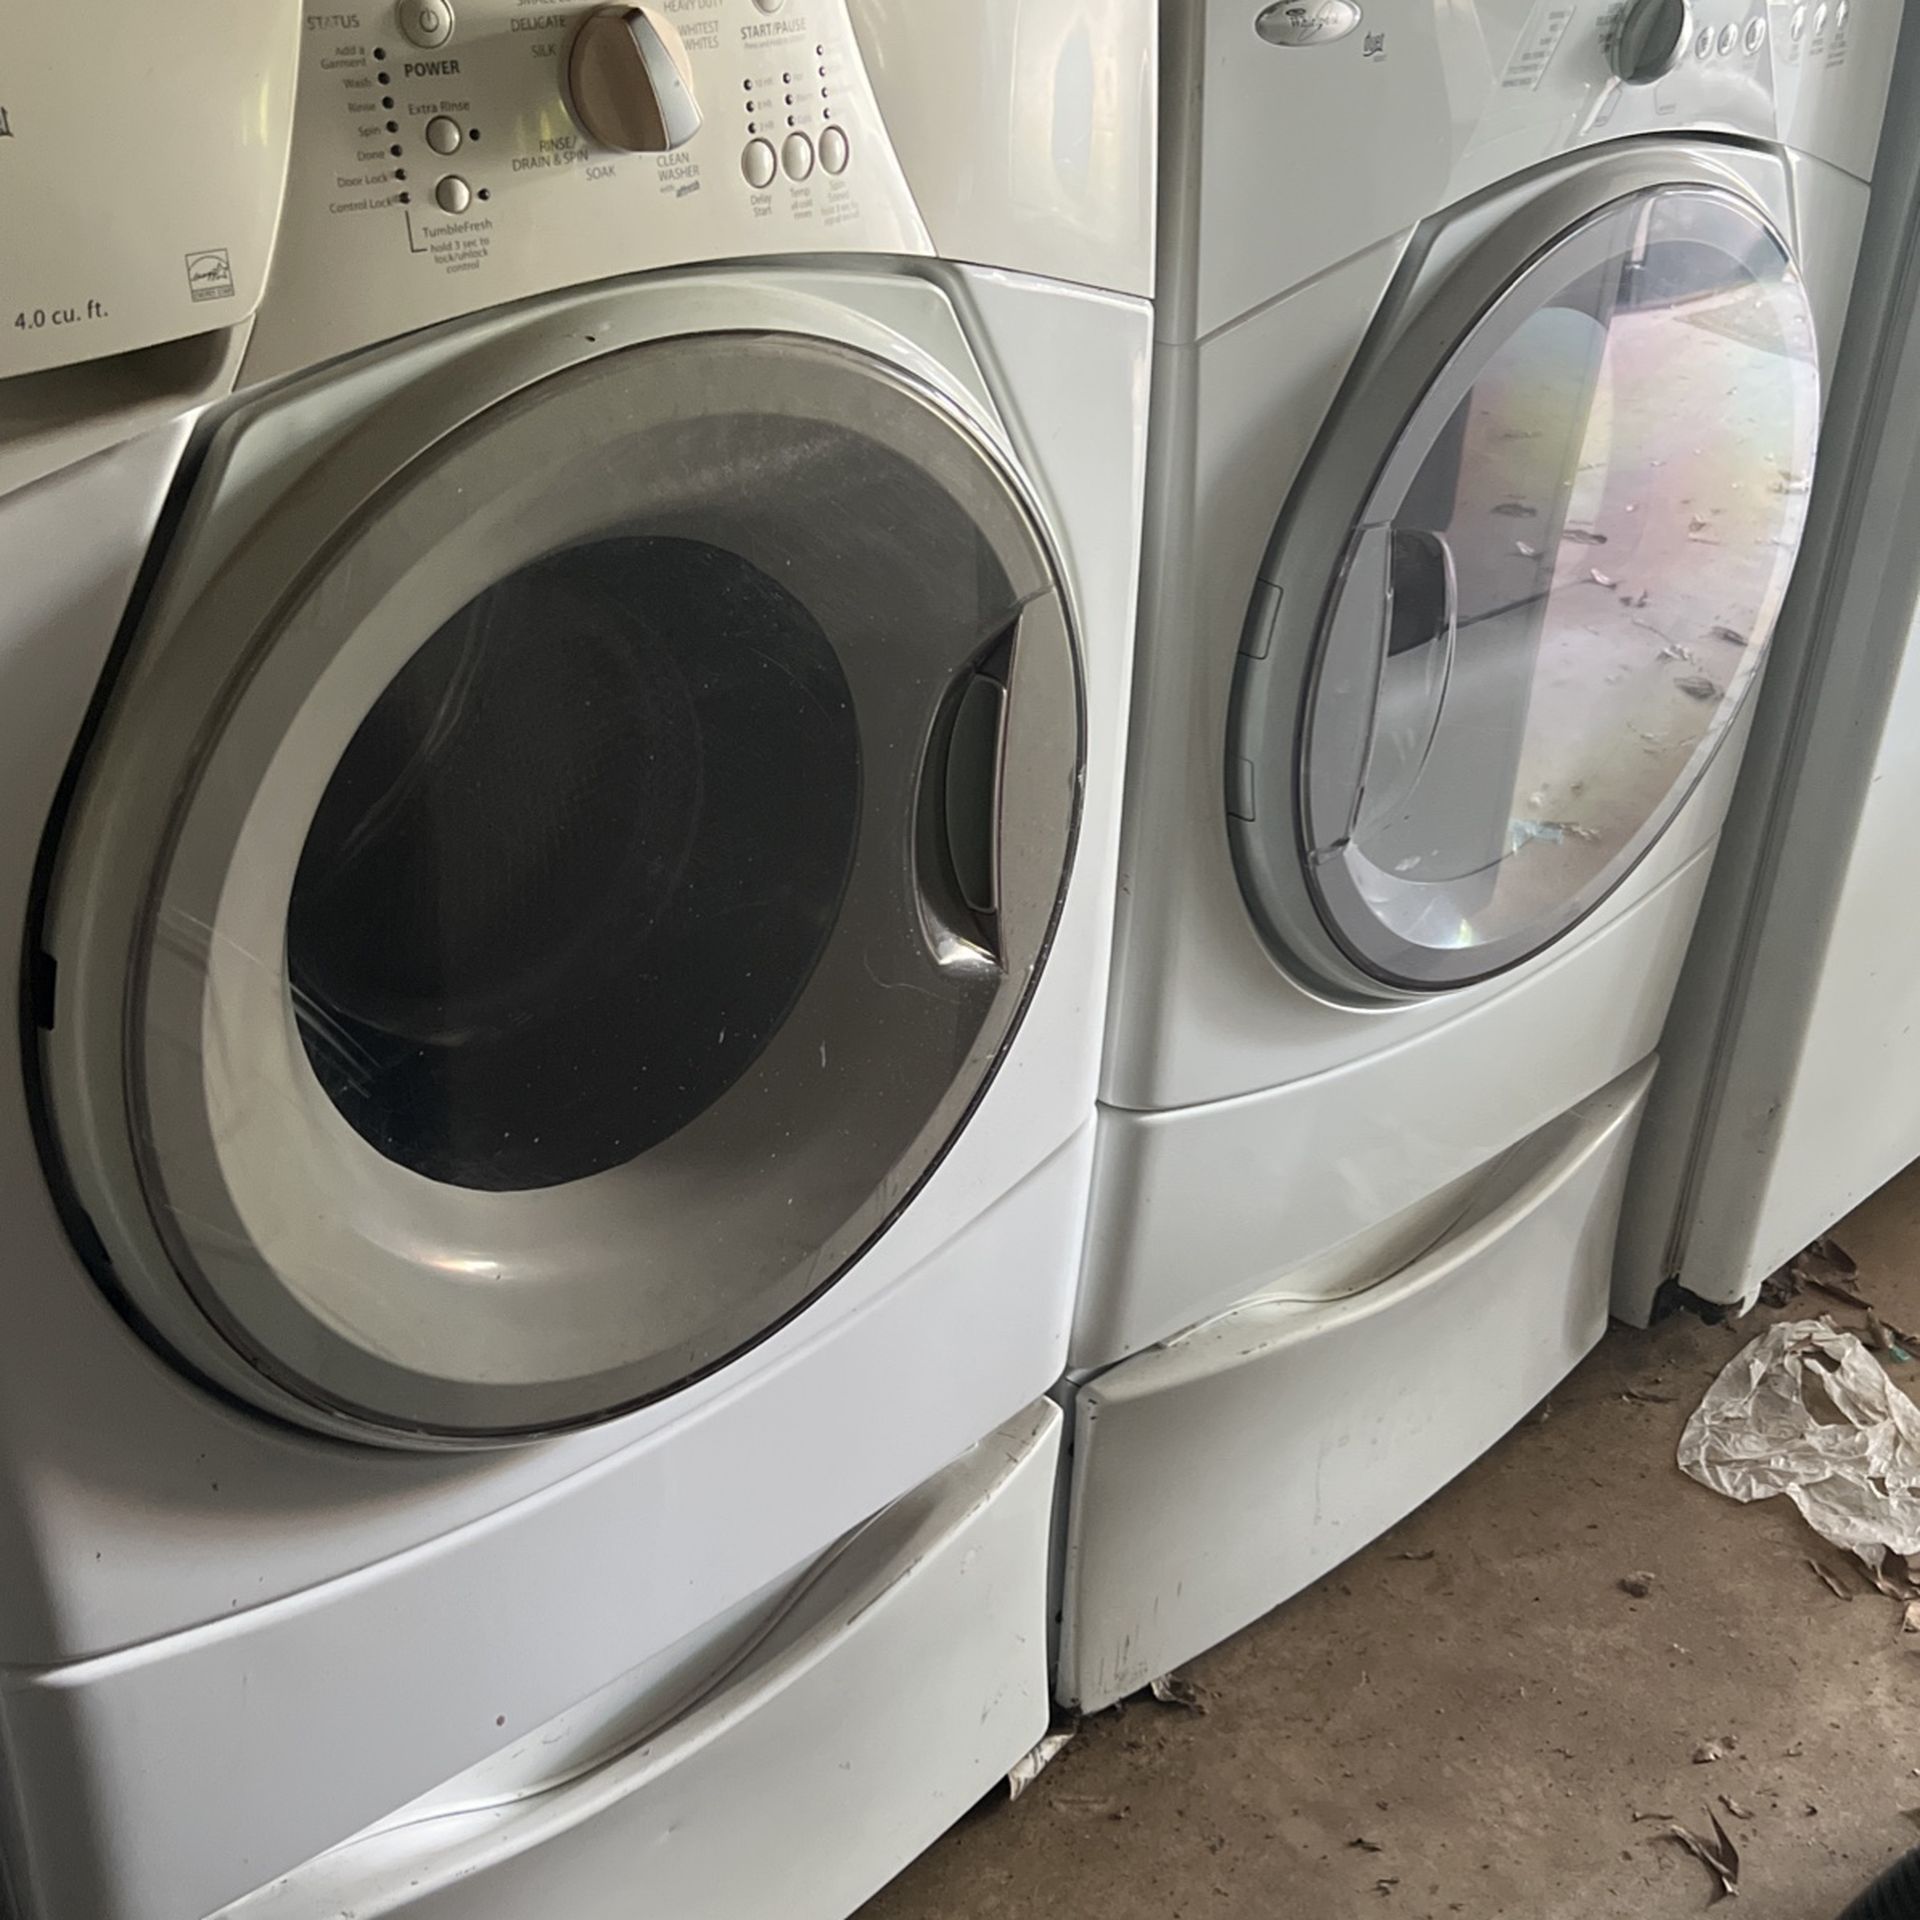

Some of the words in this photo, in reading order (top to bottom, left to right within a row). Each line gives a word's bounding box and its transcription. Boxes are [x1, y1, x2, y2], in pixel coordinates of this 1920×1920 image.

[664, 0, 695, 12] HEAVY
[698, 0, 723, 9] DUTY
[511, 15, 567, 32] DELICATE
[678, 20, 719, 36] WHITEST
[740, 18, 806, 40] START/PAUSE
[683, 35, 719, 50] WHITES
[532, 44, 557, 58] SILK
[404, 60, 460, 77] POWER
[409, 104, 438, 116] Extra
[440, 100, 470, 112] Rinse
[539, 136, 576, 152] RINSE/
[357, 150, 385, 162] Done
[512, 157, 550, 171] DRAIN
[553, 154, 562, 165] &
[564, 150, 589, 164] SPIN
[656, 152, 689, 168] CLEAN
[337, 176, 362, 188] Door
[365, 173, 388, 185] Lock
[586, 165, 615, 181] SOAK
[658, 165, 700, 182] WASHER
[330, 200, 367, 214] Control
[370, 196, 393, 209] Lock
[422, 219, 493, 238] TumbleFresh
[14, 309, 46, 330] 4.0
[52, 308, 81, 325] cu.
[87, 299, 108, 319] ft.
